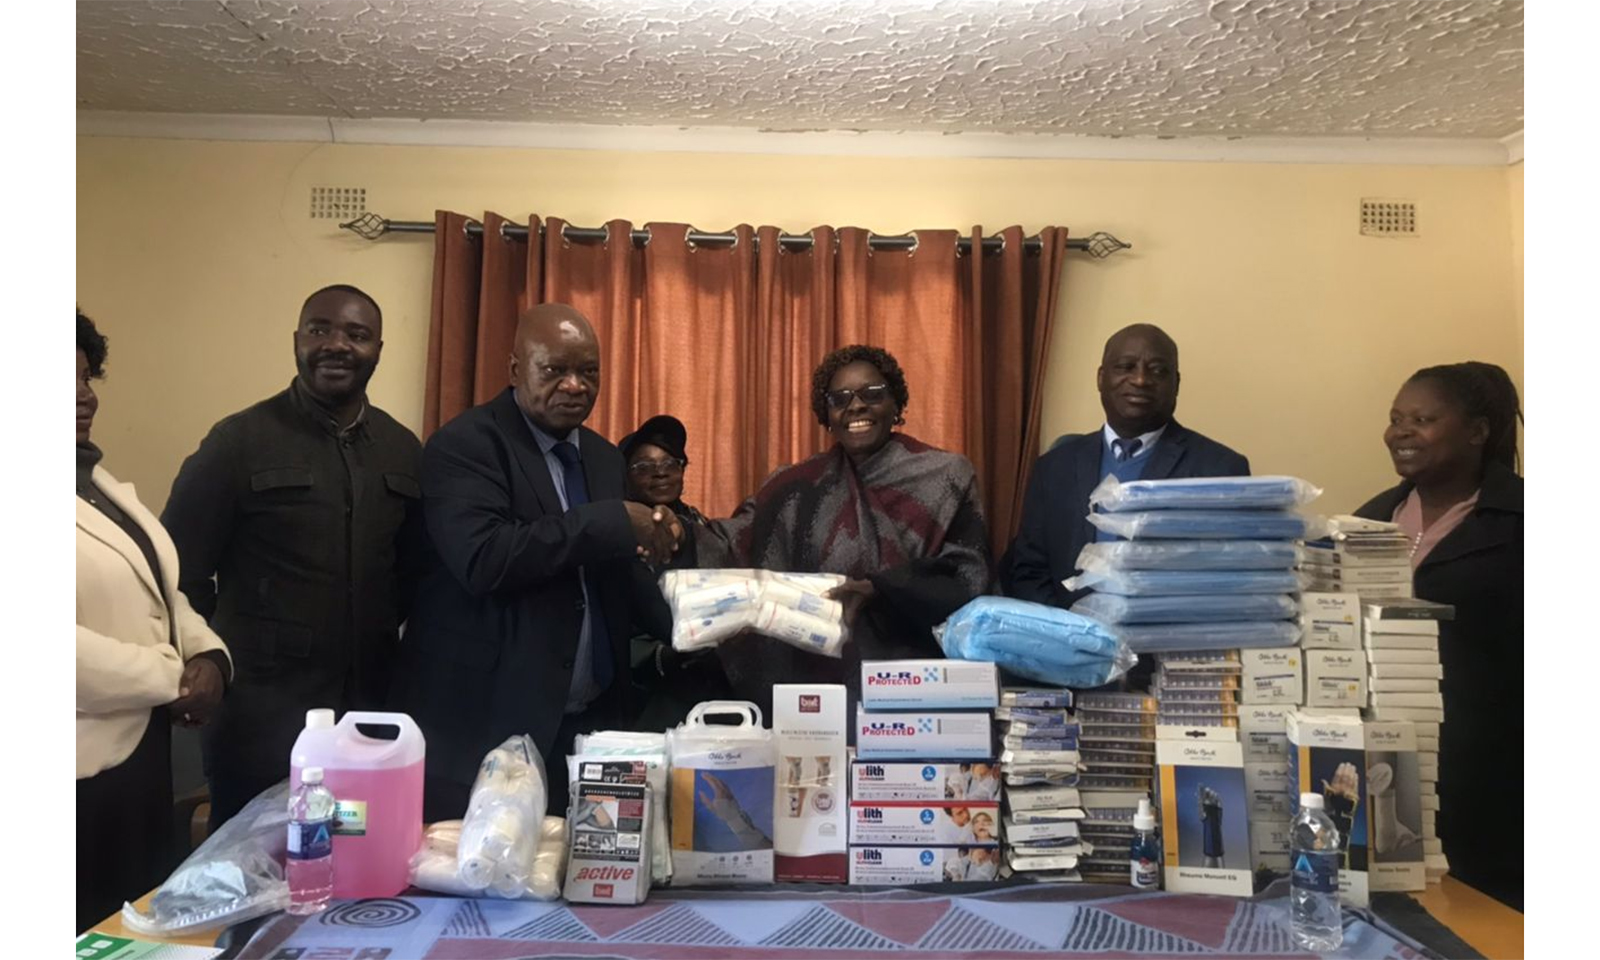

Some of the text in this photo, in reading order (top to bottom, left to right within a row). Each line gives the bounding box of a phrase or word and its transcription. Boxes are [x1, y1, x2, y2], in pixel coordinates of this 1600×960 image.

[858, 765, 884, 776] ulith
[857, 807, 883, 818] ulith
[856, 849, 882, 860] ulith
[575, 866, 634, 881] active
